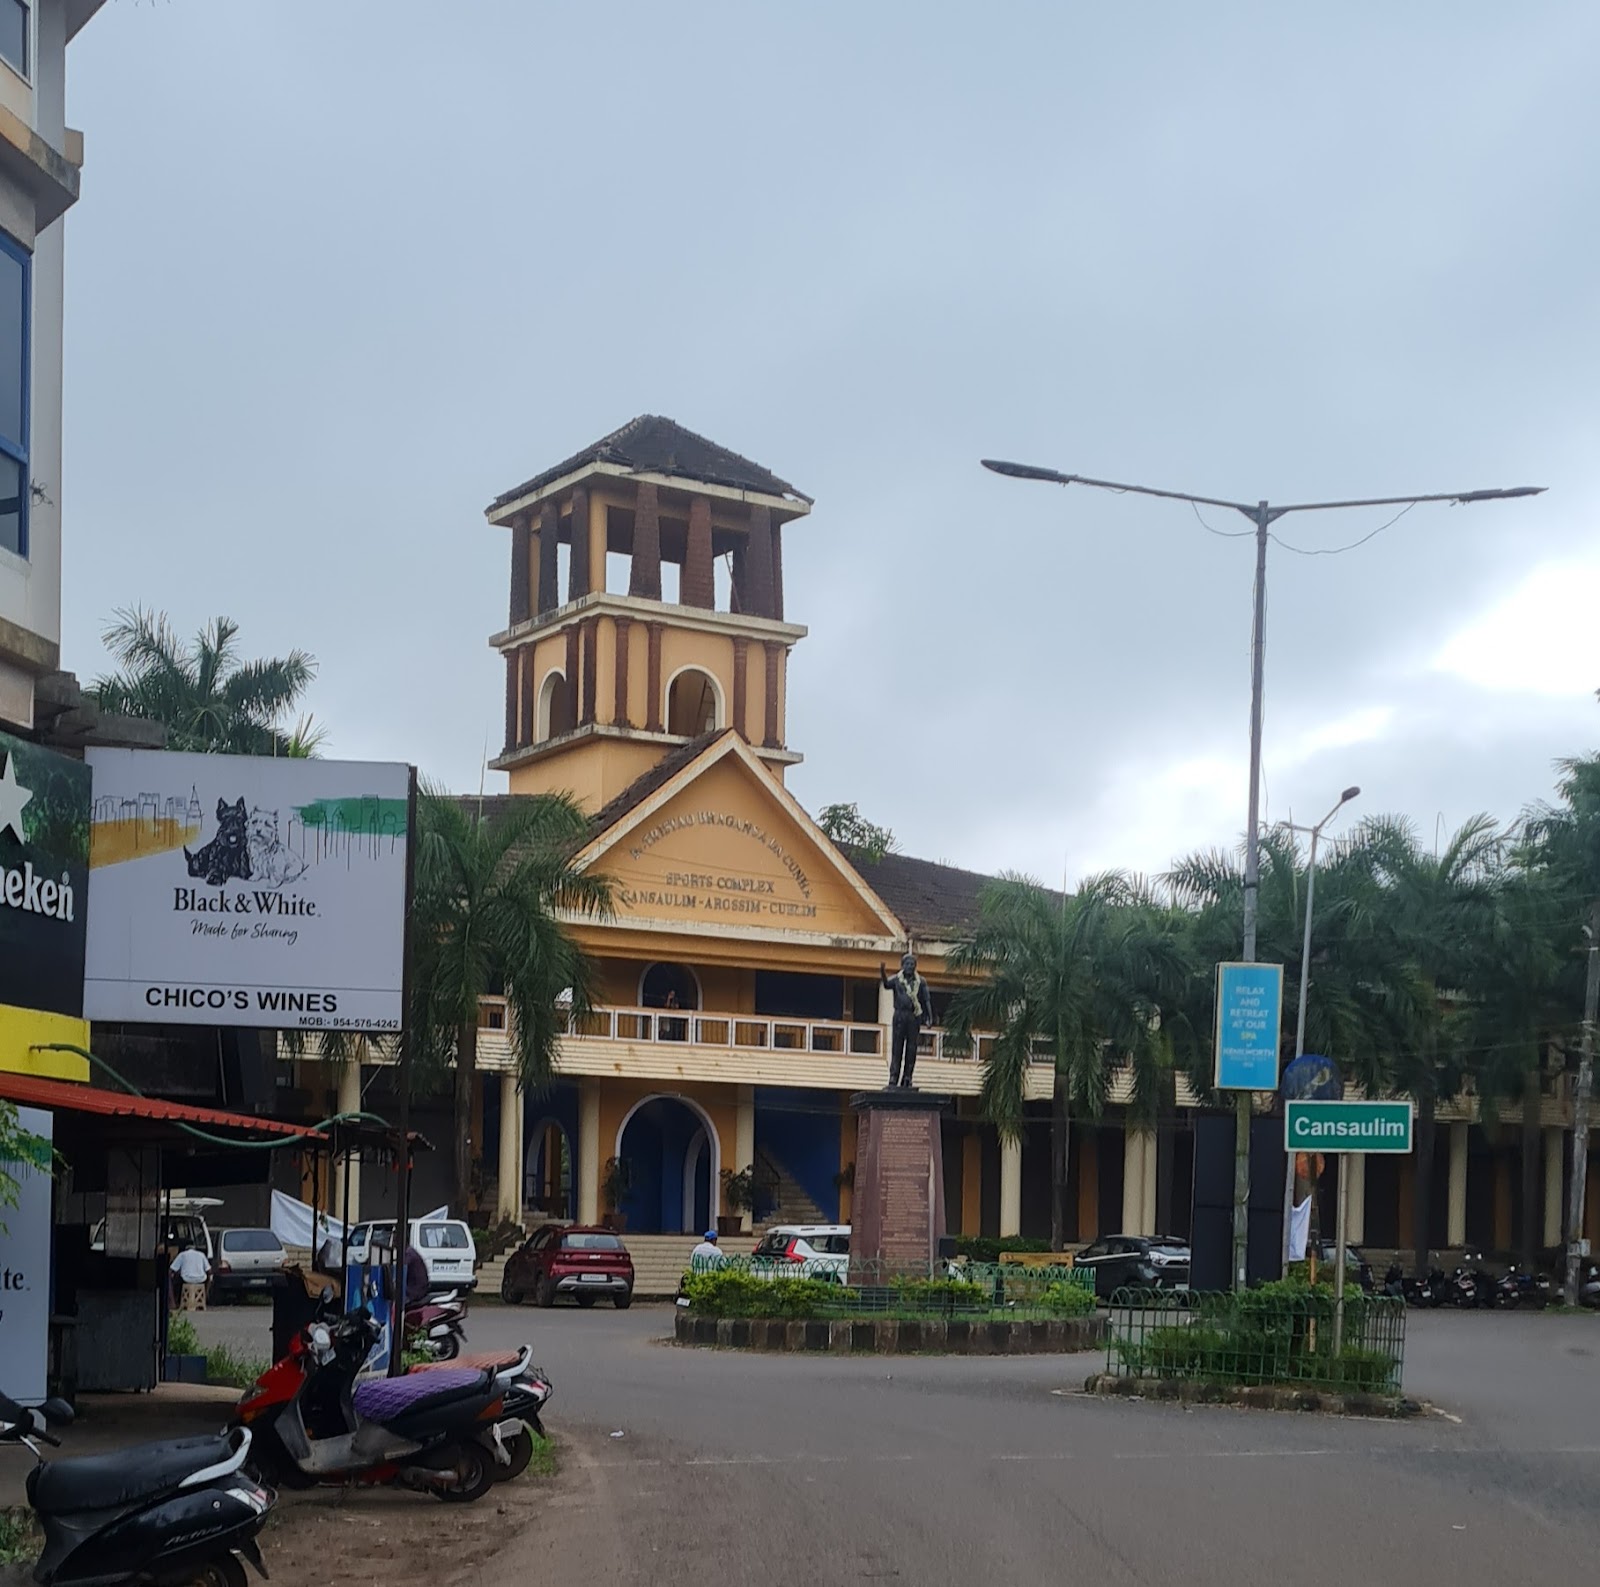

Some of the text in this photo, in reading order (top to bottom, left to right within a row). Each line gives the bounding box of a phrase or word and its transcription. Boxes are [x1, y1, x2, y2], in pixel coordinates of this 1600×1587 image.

[665, 872, 775, 894] SPORTS COMPLEX
[190, 919, 298, 946] Made for Sharing
[1235, 985, 1265, 996] RELAX
[145, 987, 337, 1013] CHICO'S WINES
[1240, 998, 1260, 1007] AND
[1229, 1008, 1269, 1018] RETREAT
[1231, 1020, 1266, 1030] AT OUR
[1295, 1116, 1405, 1136] Cansaulim
